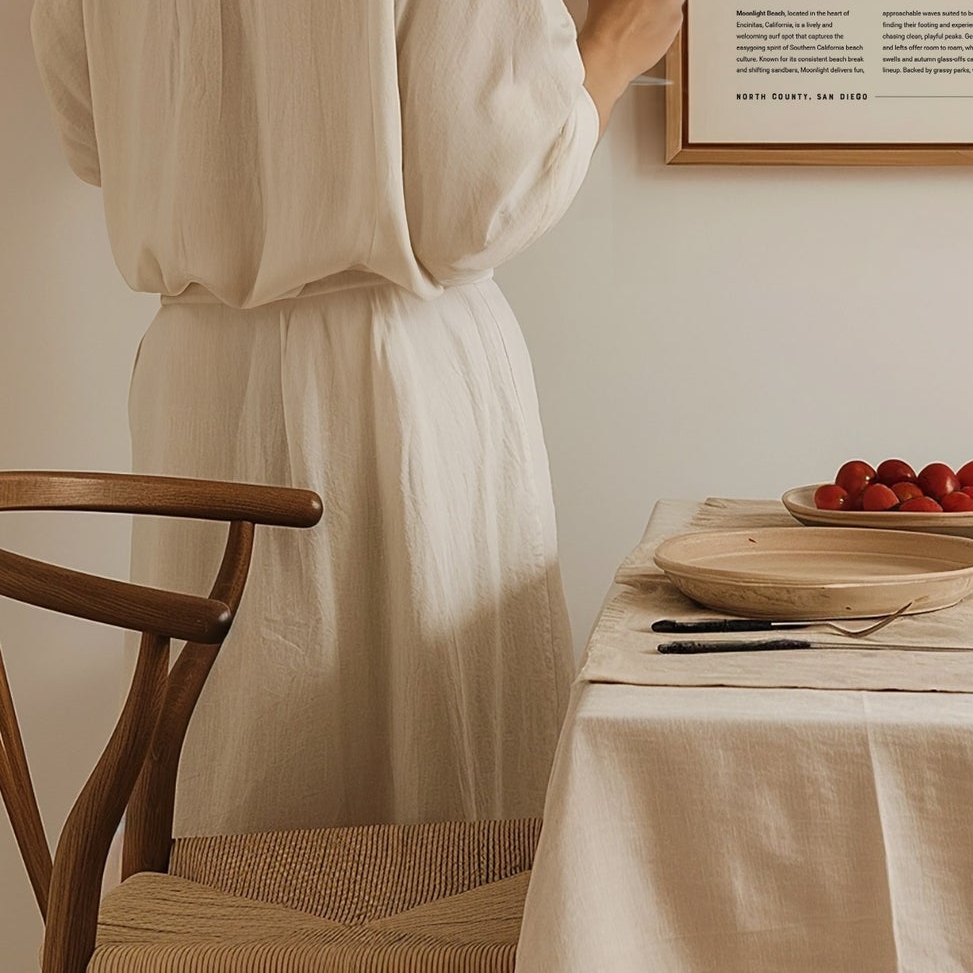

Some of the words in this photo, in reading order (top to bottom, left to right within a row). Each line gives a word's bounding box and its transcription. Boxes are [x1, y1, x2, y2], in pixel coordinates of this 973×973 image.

[736, 10, 765, 18] Moonlight
[767, 10, 786, 18] Beach,
[883, 10, 921, 18] approachable
[736, 44, 765, 52] easygoing
[767, 44, 781, 52] spirit
[736, 92, 766, 100] NORTH
[772, 92, 812, 101] COUNTY,
[817, 92, 834, 100] SAN
[840, 92, 868, 100] DIEGO
